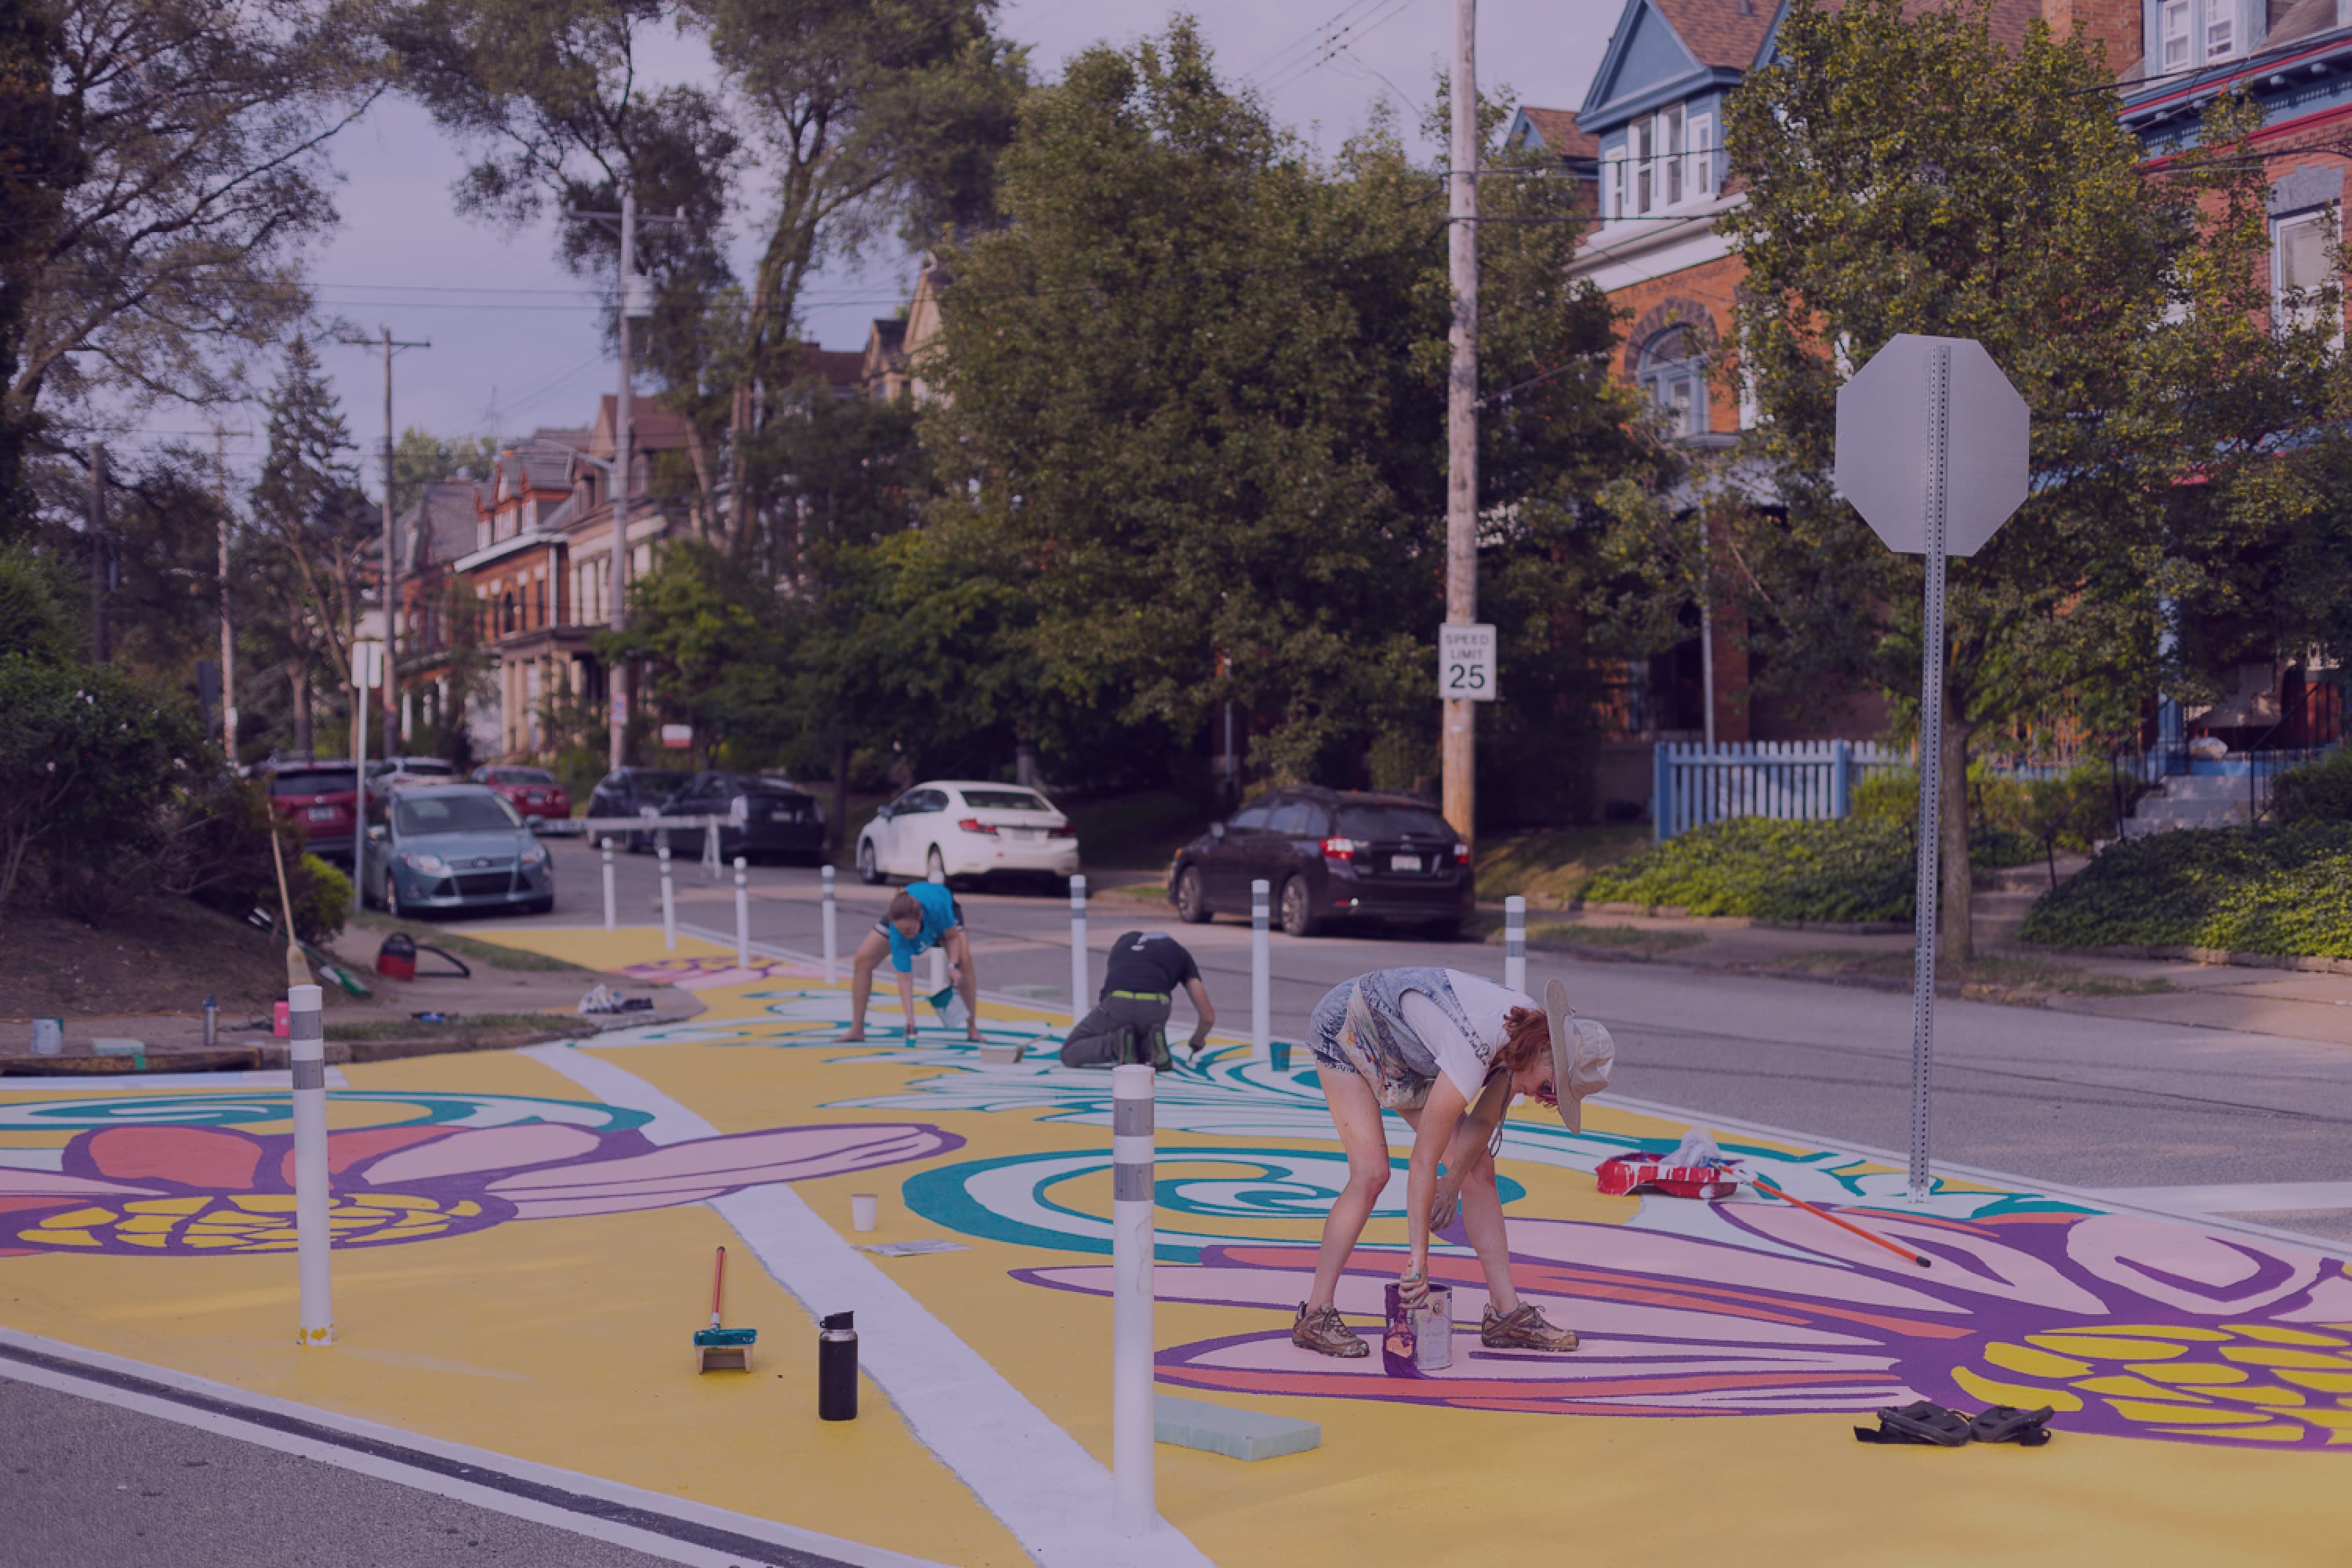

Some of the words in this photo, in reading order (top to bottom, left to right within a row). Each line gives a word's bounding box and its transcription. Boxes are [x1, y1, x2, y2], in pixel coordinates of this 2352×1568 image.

[1446, 633, 1489, 644] SPEED
[1450, 649, 1483, 659] LIMIT
[1450, 664, 1485, 688] 25
